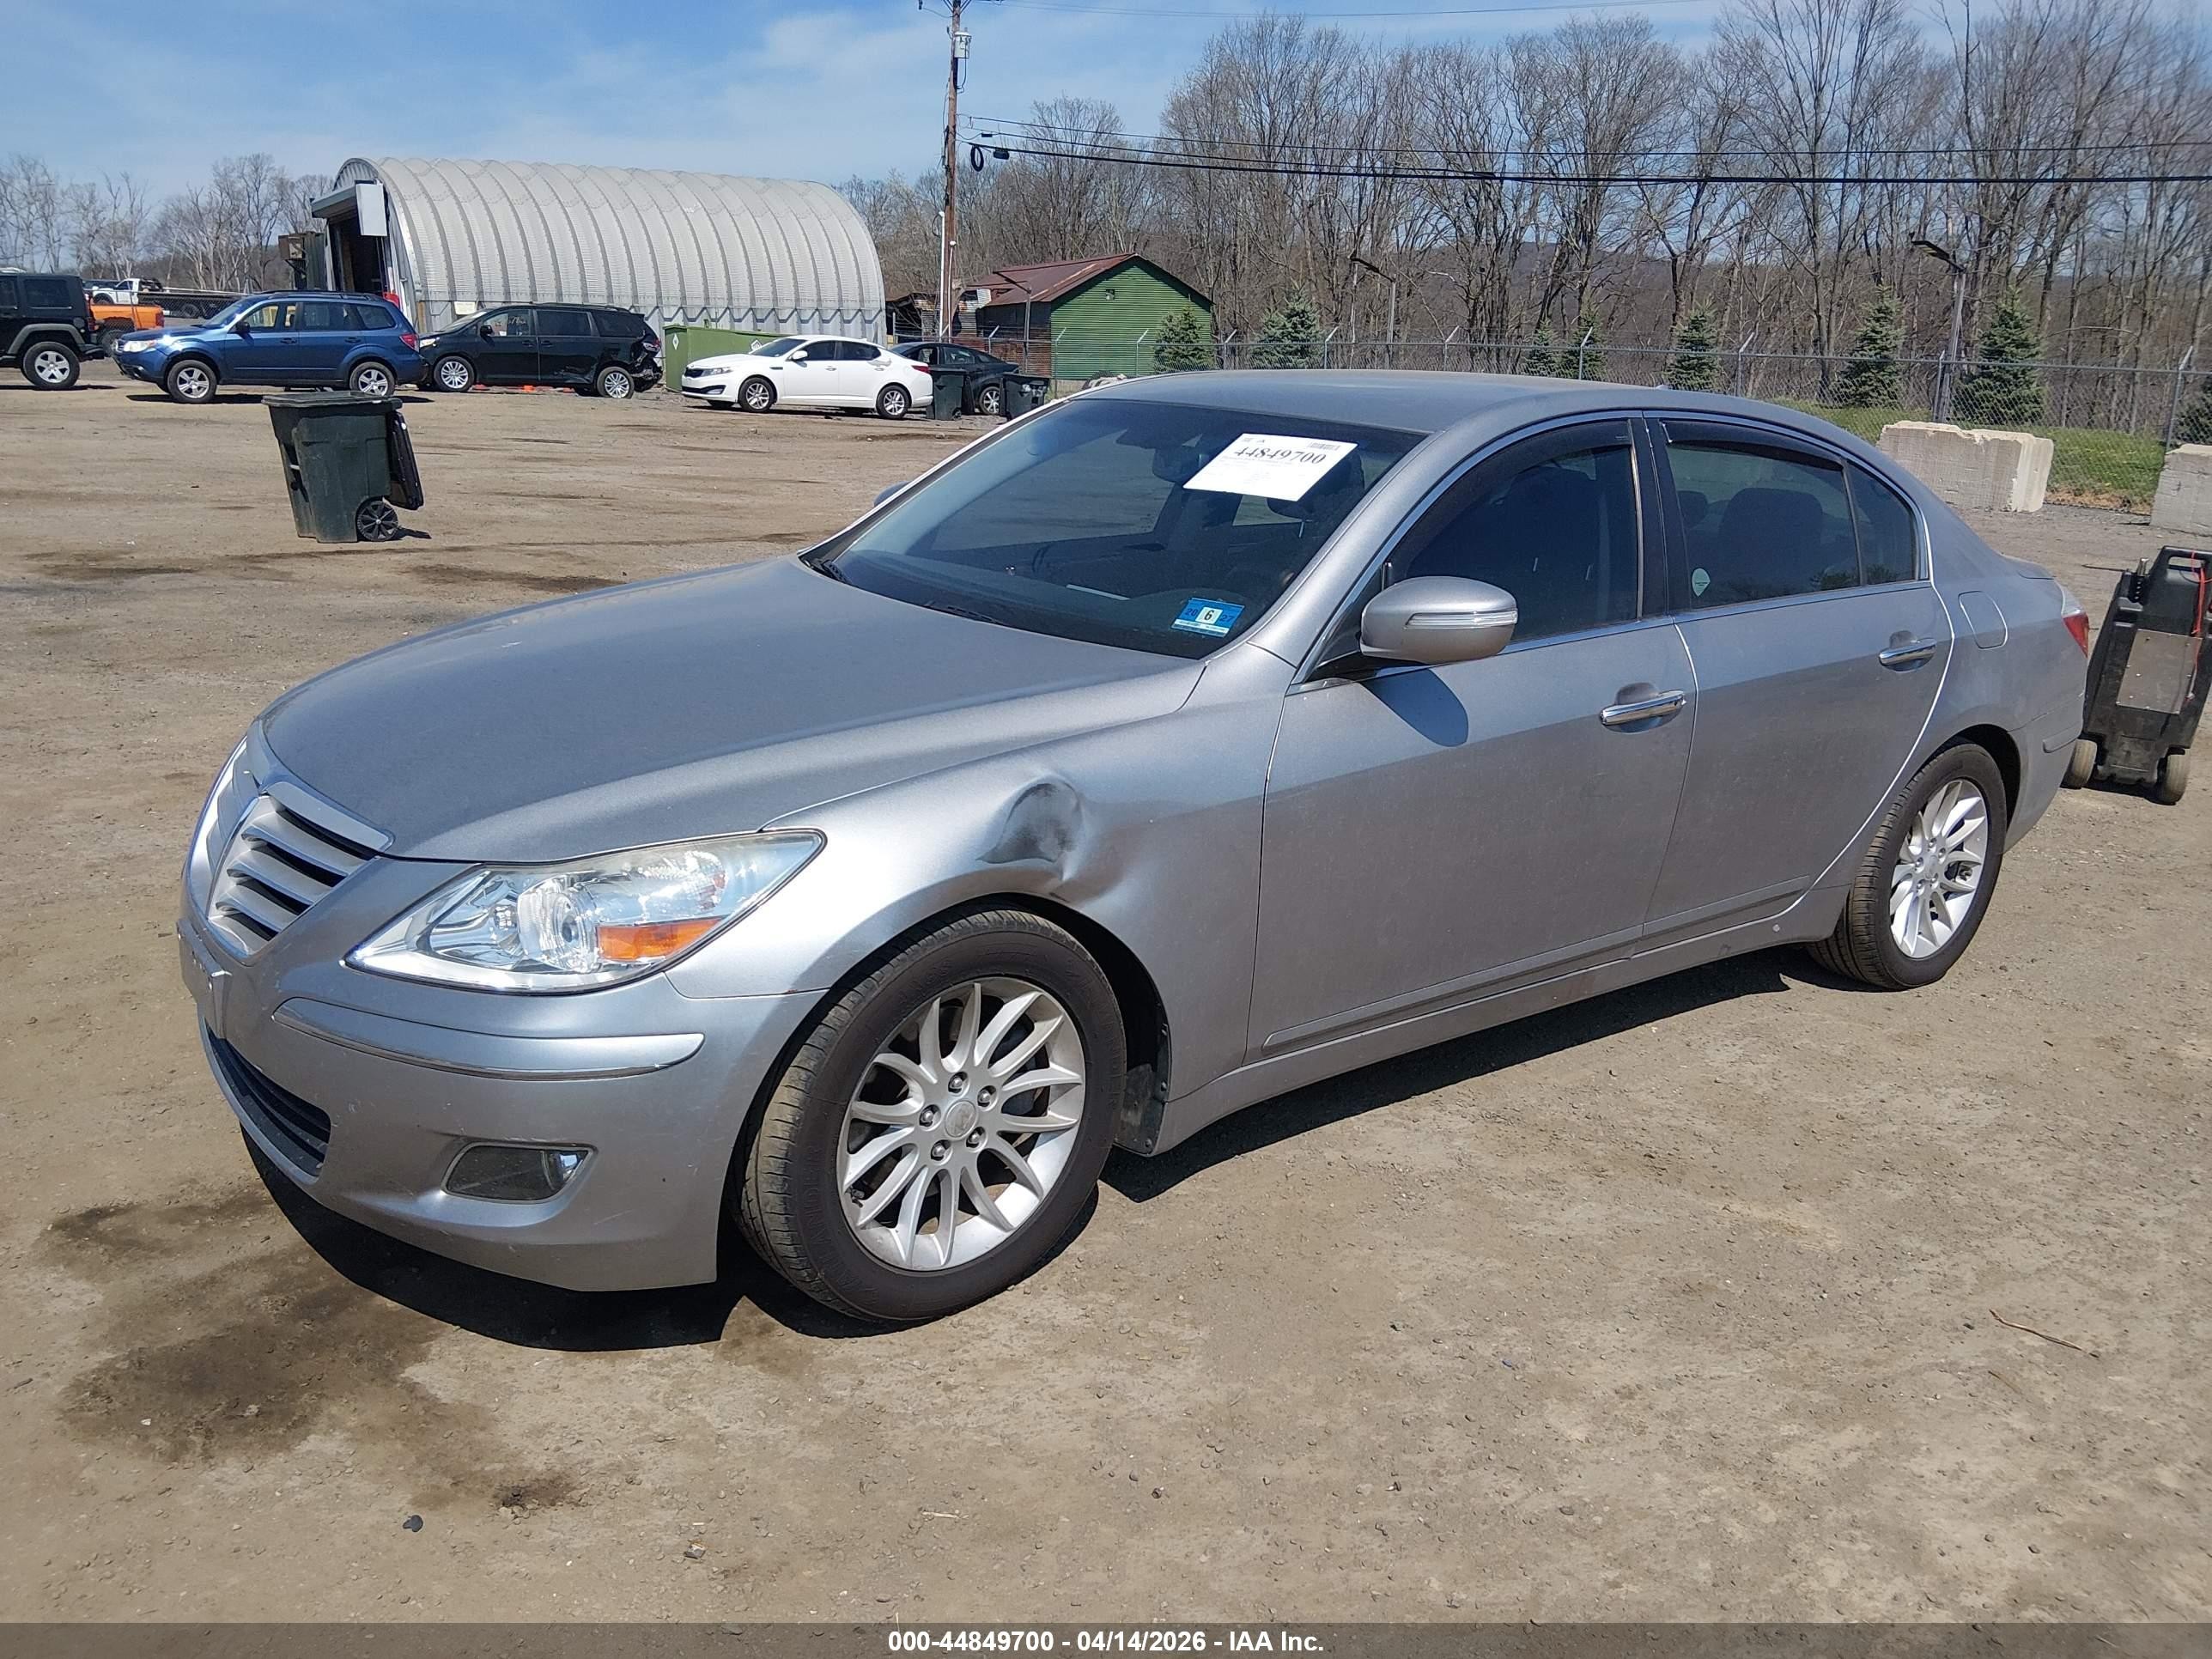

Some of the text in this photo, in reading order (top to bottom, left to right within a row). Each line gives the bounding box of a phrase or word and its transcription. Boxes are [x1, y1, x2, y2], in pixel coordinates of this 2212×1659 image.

[1234, 447, 1327, 465] 44849700
[1204, 610, 1215, 621] 6
[1219, 614, 1235, 623] 27
